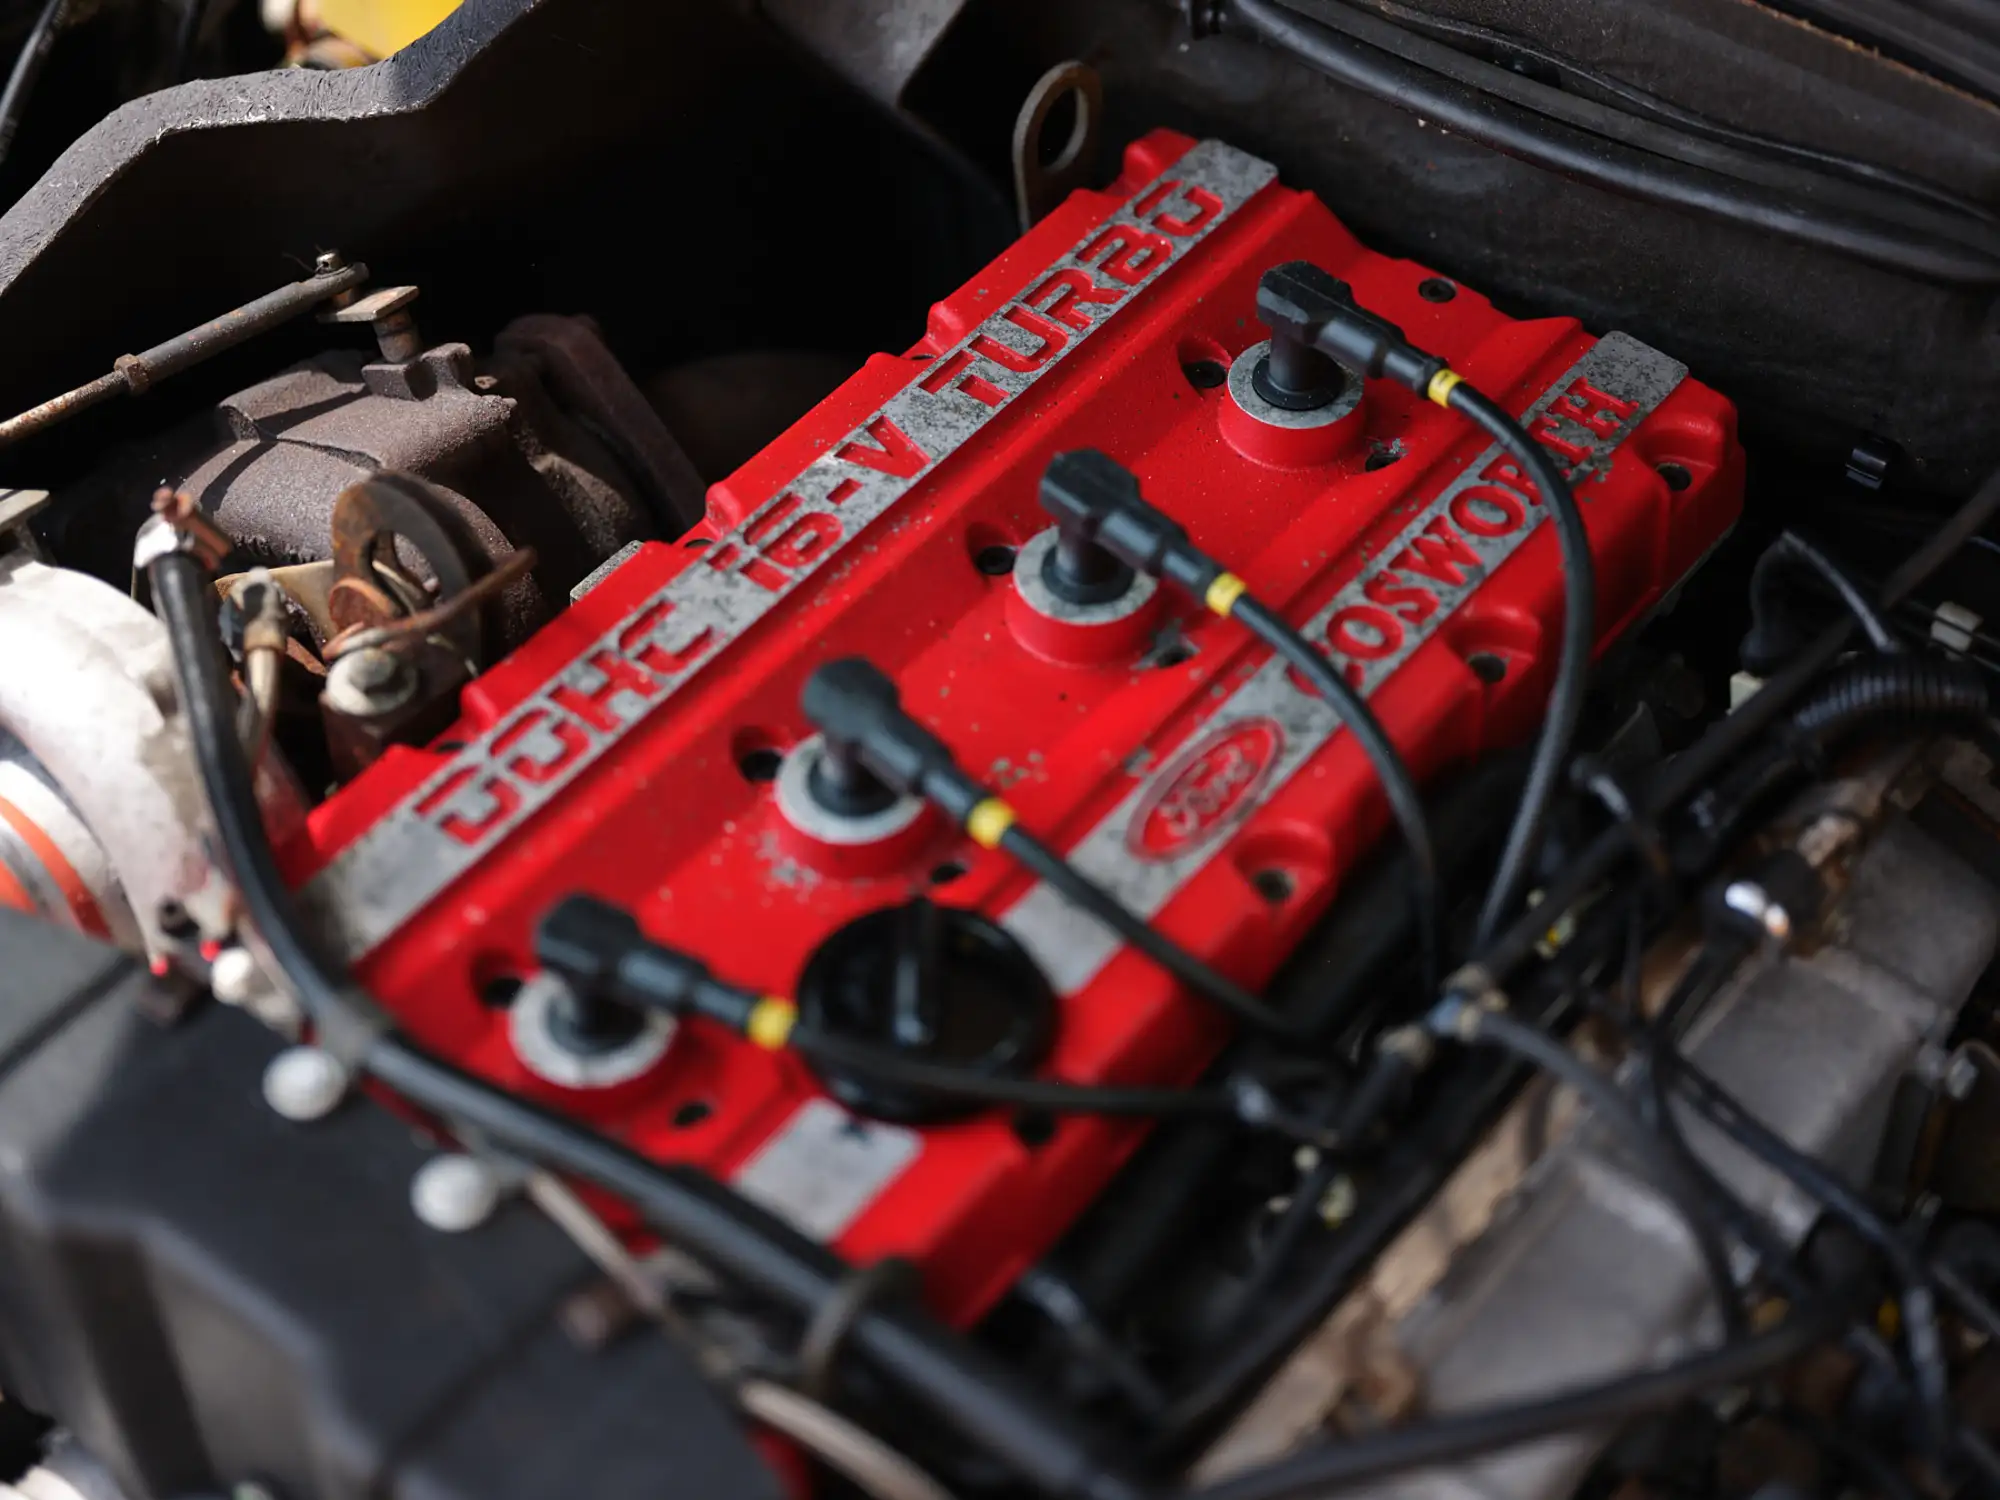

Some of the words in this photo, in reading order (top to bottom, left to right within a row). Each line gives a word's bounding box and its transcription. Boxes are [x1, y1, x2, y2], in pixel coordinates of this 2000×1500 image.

[411, 600, 725, 846] DOHC
[706, 413, 932, 593] 16-V
[917, 179, 1224, 408] TURBO
